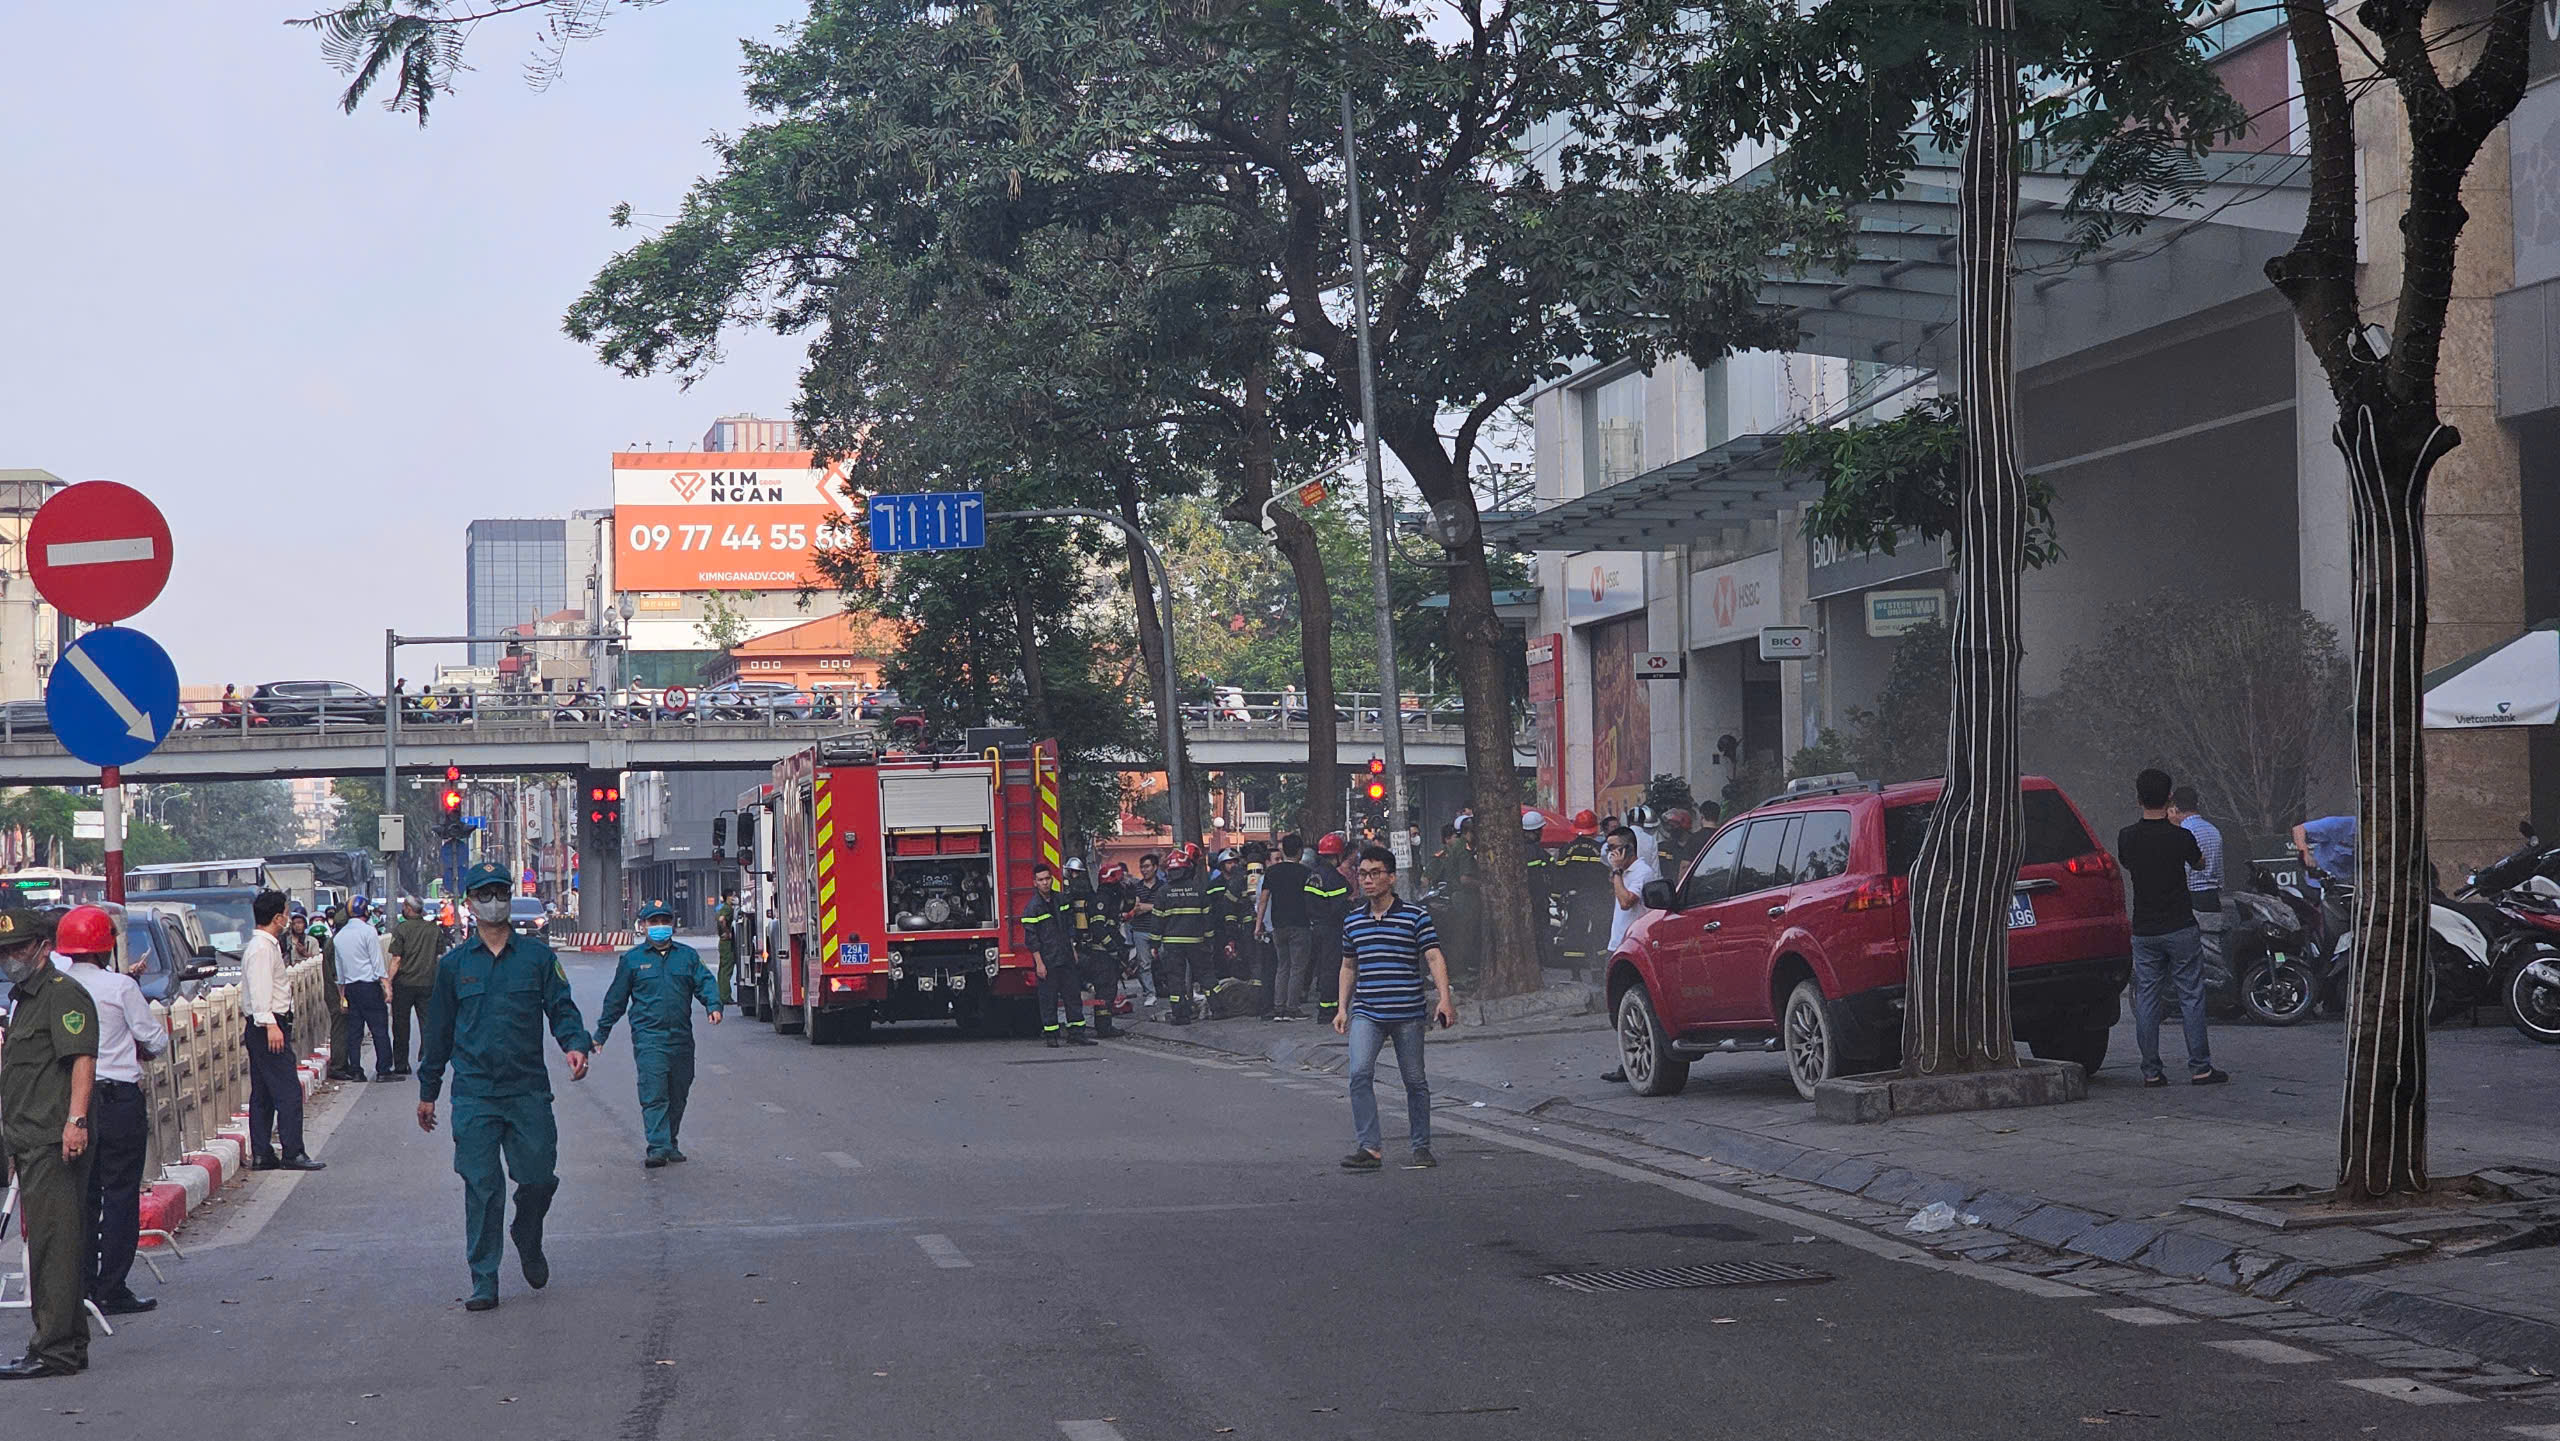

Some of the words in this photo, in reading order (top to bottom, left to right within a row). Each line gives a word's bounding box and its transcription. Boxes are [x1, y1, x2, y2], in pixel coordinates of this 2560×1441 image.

[711, 471, 757, 486] KIM
[711, 487, 783, 502] NGAN
[629, 523, 672, 551] 09
[678, 523, 714, 551] 77
[720, 523, 762, 550] 44
[769, 523, 807, 550] 55
[698, 571, 796, 583] KIMNGANADV.COM
[1738, 582, 1760, 609] HSBC
[1771, 638, 1792, 646] BIC
[2455, 713, 2517, 724] Vietcombank
[846, 944, 863, 954] 29A
[842, 953, 869, 963] 026.17
